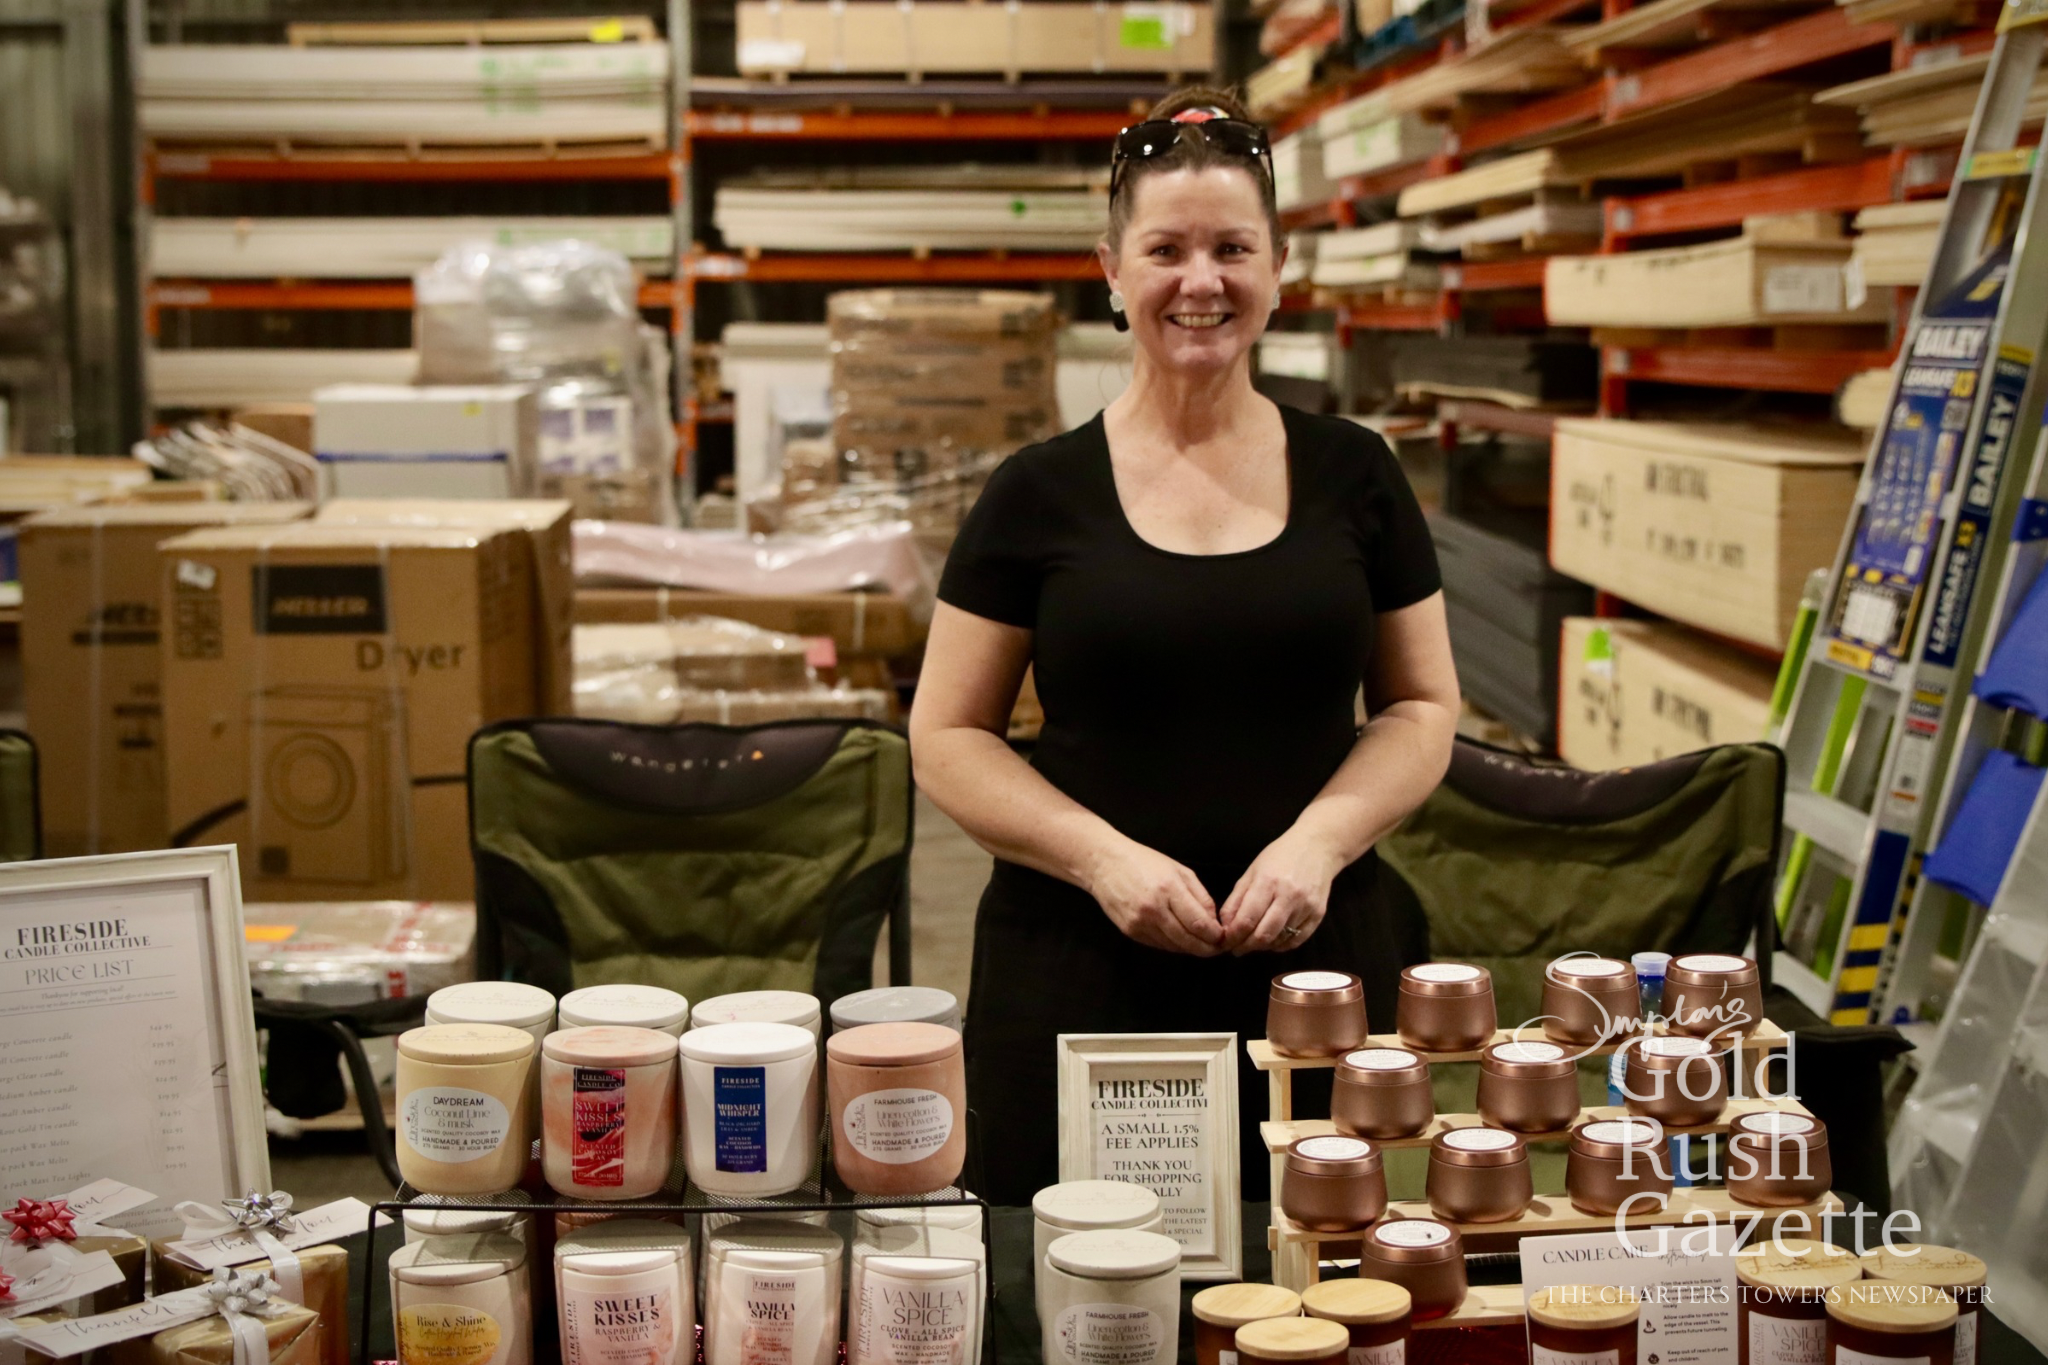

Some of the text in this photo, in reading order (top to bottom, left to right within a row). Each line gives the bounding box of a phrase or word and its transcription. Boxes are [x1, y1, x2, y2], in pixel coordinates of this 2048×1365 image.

[1912, 326, 1988, 359] BAILEY
[1968, 392, 2015, 508] BAILEY
[1928, 549, 1970, 655] LEANSAFE
[17, 918, 129, 946] FIRESIDE
[4, 935, 152, 960] CANDLE COLLECTIVE
[25, 959, 135, 986] PRICE LIST
[48, 1032, 73, 1042] candle
[45, 1051, 69, 1060] candle
[40, 1068, 65, 1078] candle
[28, 1088, 51, 1098] Amber
[53, 1084, 78, 1094] candle
[1098, 1078, 1204, 1099] FIRESIDE
[433, 1096, 484, 1106] DAYDREAM
[874, 1094, 938, 1106] FARMHOUSE FRESH
[1091, 1100, 1137, 1111] CANDLE
[21, 1102, 72, 1115] Amber candle
[424, 1105, 464, 1119] Coconut
[576, 1101, 619, 1112] SWEET
[717, 1103, 761, 1111] MIDNIGHT
[576, 1112, 621, 1122] KISSES
[876, 1106, 929, 1120] Linen cotton
[54, 1119, 79, 1129] candle
[447, 1119, 475, 1129] musk
[877, 1116, 941, 1128] White Flowers
[1101, 1123, 1200, 1136] A SMALL 1.5%
[30, 1142, 46, 1150] Wax
[50, 1138, 70, 1147] Melts
[422, 1136, 460, 1146] HANDMADE
[471, 1137, 499, 1146] POURED
[872, 1138, 912, 1146] HANDMADE
[921, 1132, 947, 1143] POURED
[1106, 1136, 1199, 1149] FEE APPLIES
[8, 1156, 69, 1173] pack Wax Melts
[1113, 1160, 1192, 1171] THANK YOU
[10, 1179, 27, 1190] pack
[68, 1171, 91, 1182] Lights
[1104, 1173, 1202, 1184] FOR SHOPPING
[1180, 1217, 1208, 1225] LATEST
[1543, 1248, 1605, 1264] CANDLE
[1608, 1244, 1649, 1261] CARE
[594, 1294, 658, 1313] SWEET
[882, 1287, 964, 1309] VANILLA
[747, 1300, 796, 1312] VANILLA
[594, 1308, 660, 1326] KISSES
[751, 1309, 791, 1320] SPICE
[892, 1307, 953, 1326] SPICE
[1085, 1311, 1150, 1320] FARMHOUSE FRESH
[416, 1315, 486, 1328] Rise & Shine
[595, 1324, 650, 1335] RASPBERRY
[880, 1324, 965, 1336] CLOVE ALL SPICE
[1113, 1323, 1141, 1333] cotton
[608, 1332, 650, 1343] VANILLA
[888, 1332, 955, 1342] VANILLA BEAN
[1115, 1332, 1151, 1342] Flowers
[891, 1343, 920, 1351] SCENTED
[1081, 1349, 1156, 1360] HANDMADE POURED
